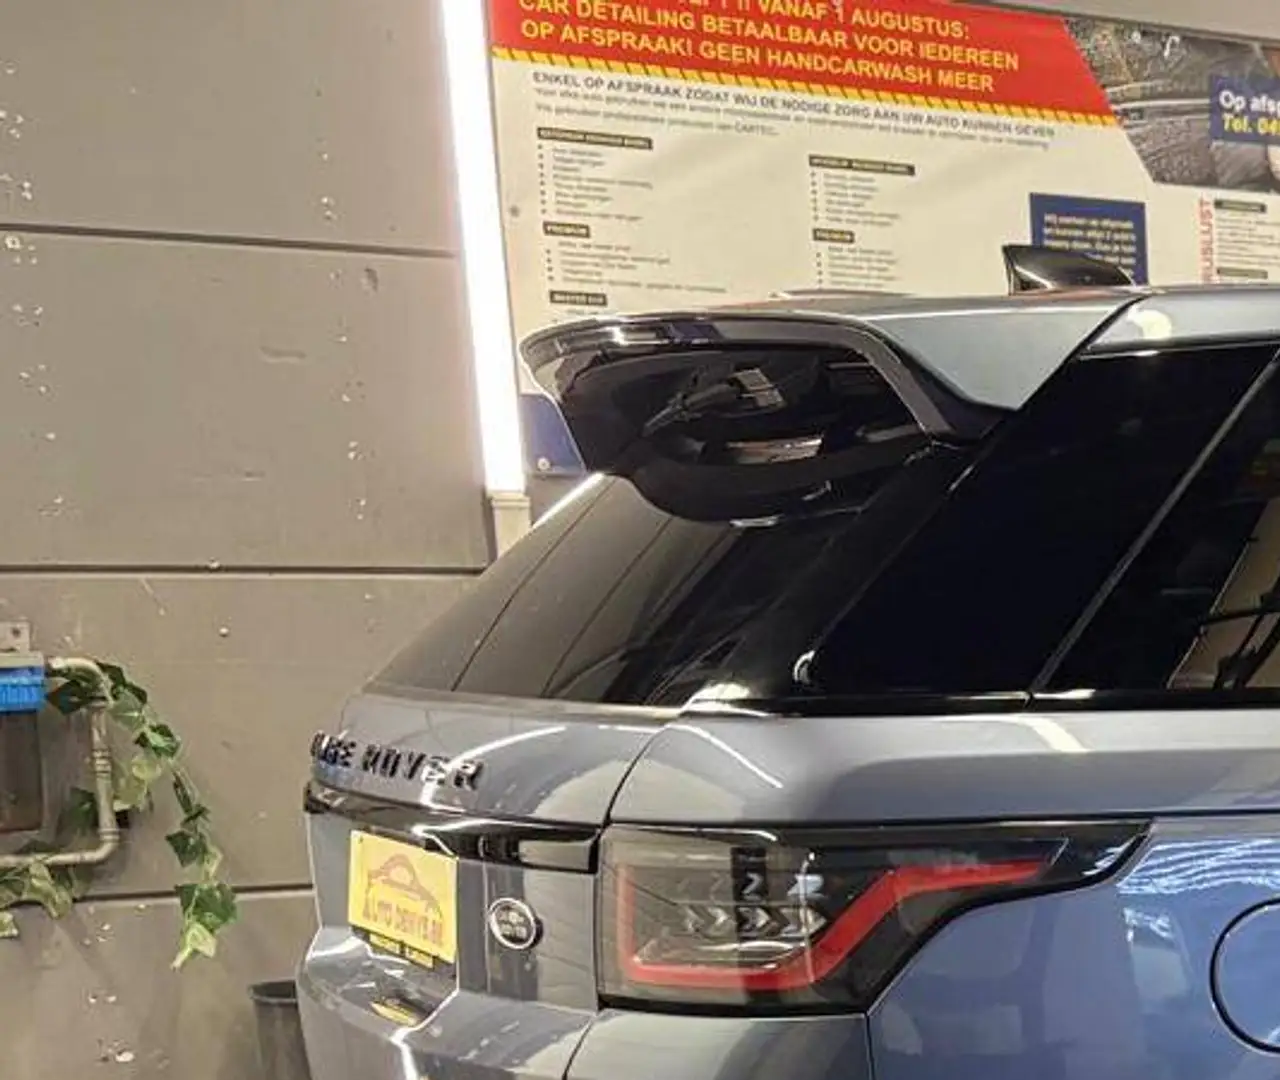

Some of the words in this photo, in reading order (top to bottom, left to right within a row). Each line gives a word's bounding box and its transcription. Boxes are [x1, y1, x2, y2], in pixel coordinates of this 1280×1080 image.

[519, 0, 571, 16] CAR
[576, 0, 697, 31] DETAILING
[702, 14, 849, 48] BETAALBAAR
[853, 33, 914, 57] VOOR
[919, 42, 1019, 71] IEDEREEN
[757, 0, 828, 21] VANAF
[851, 8, 970, 40] AUGUSTUS:
[521, 19, 555, 39] OP
[560, 24, 693, 56] AFSPRAAK!
[700, 40, 760, 66] GEEN
[767, 48, 932, 85] HANDCARWASH
[938, 70, 995, 92] MEER
[532, 72, 581, 87] ENKEL
[583, 76, 603, 89] OP
[607, 79, 681, 97] AFSPRAAK
[926, 114, 960, 128] AUTO
[1219, 90, 1246, 112] Op
[1222, 113, 1252, 133] Tel.
